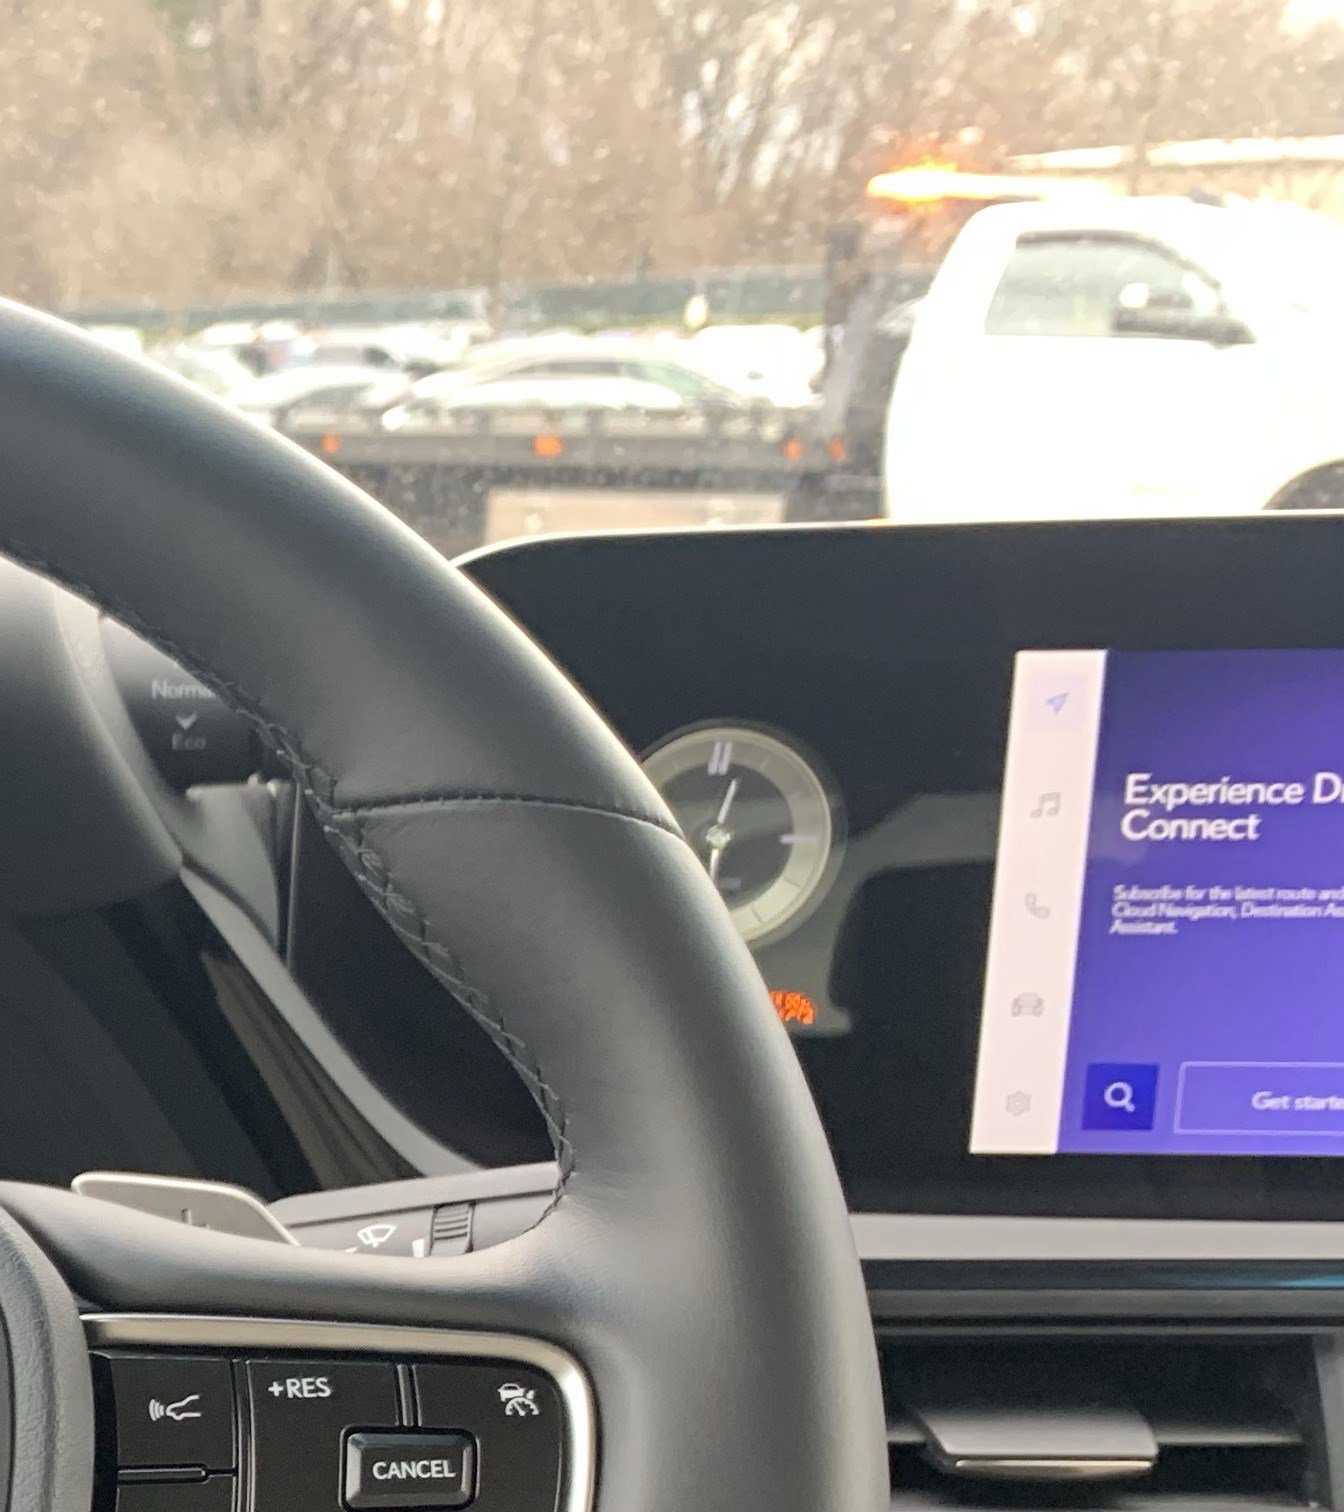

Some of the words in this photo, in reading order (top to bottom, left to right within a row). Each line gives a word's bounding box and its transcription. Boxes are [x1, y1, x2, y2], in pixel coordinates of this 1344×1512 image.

[1124, 772, 1305, 812] Experience
[1120, 808, 1263, 841] Connect
[1252, 1090, 1289, 1112] Get
[371, 1458, 457, 1481] CANCEL
